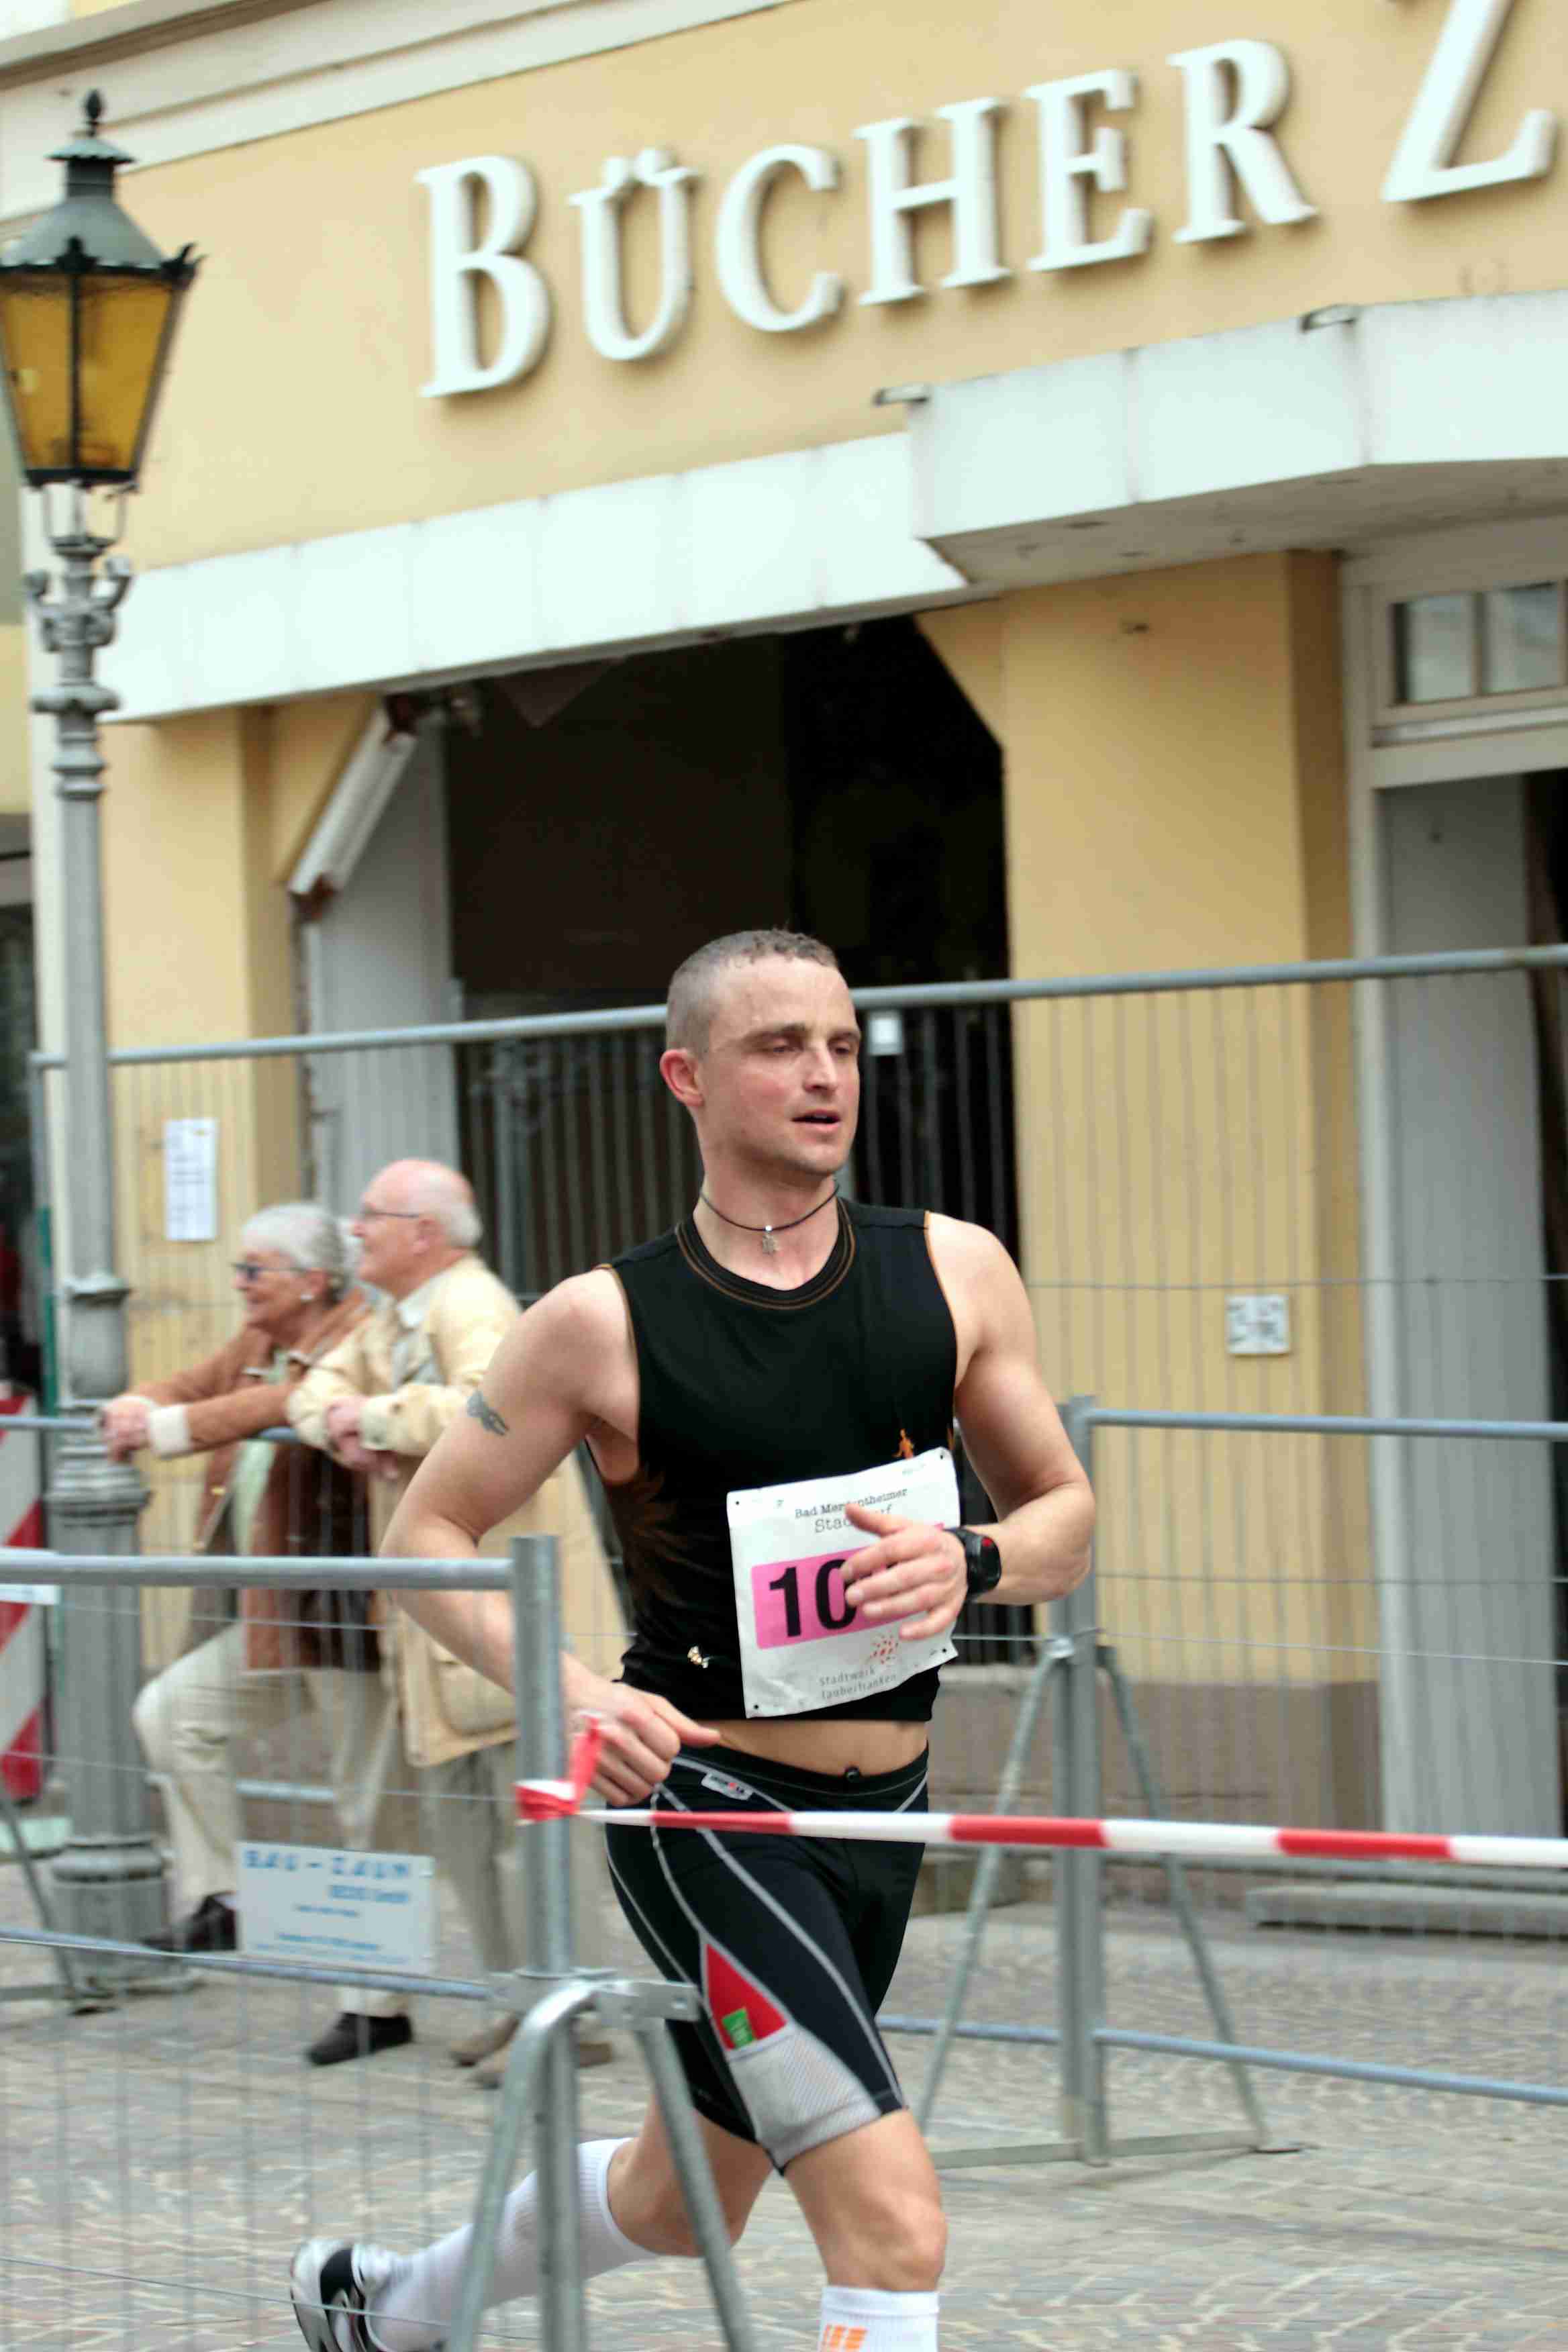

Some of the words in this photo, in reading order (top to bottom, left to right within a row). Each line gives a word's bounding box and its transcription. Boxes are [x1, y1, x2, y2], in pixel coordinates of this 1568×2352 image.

[414, 39, 1320, 398] BÜCHER
[795, 1506, 817, 1518] Bad
[820, 1488, 908, 1514] Merntheimer
[769, 1559, 873, 1637] 10
